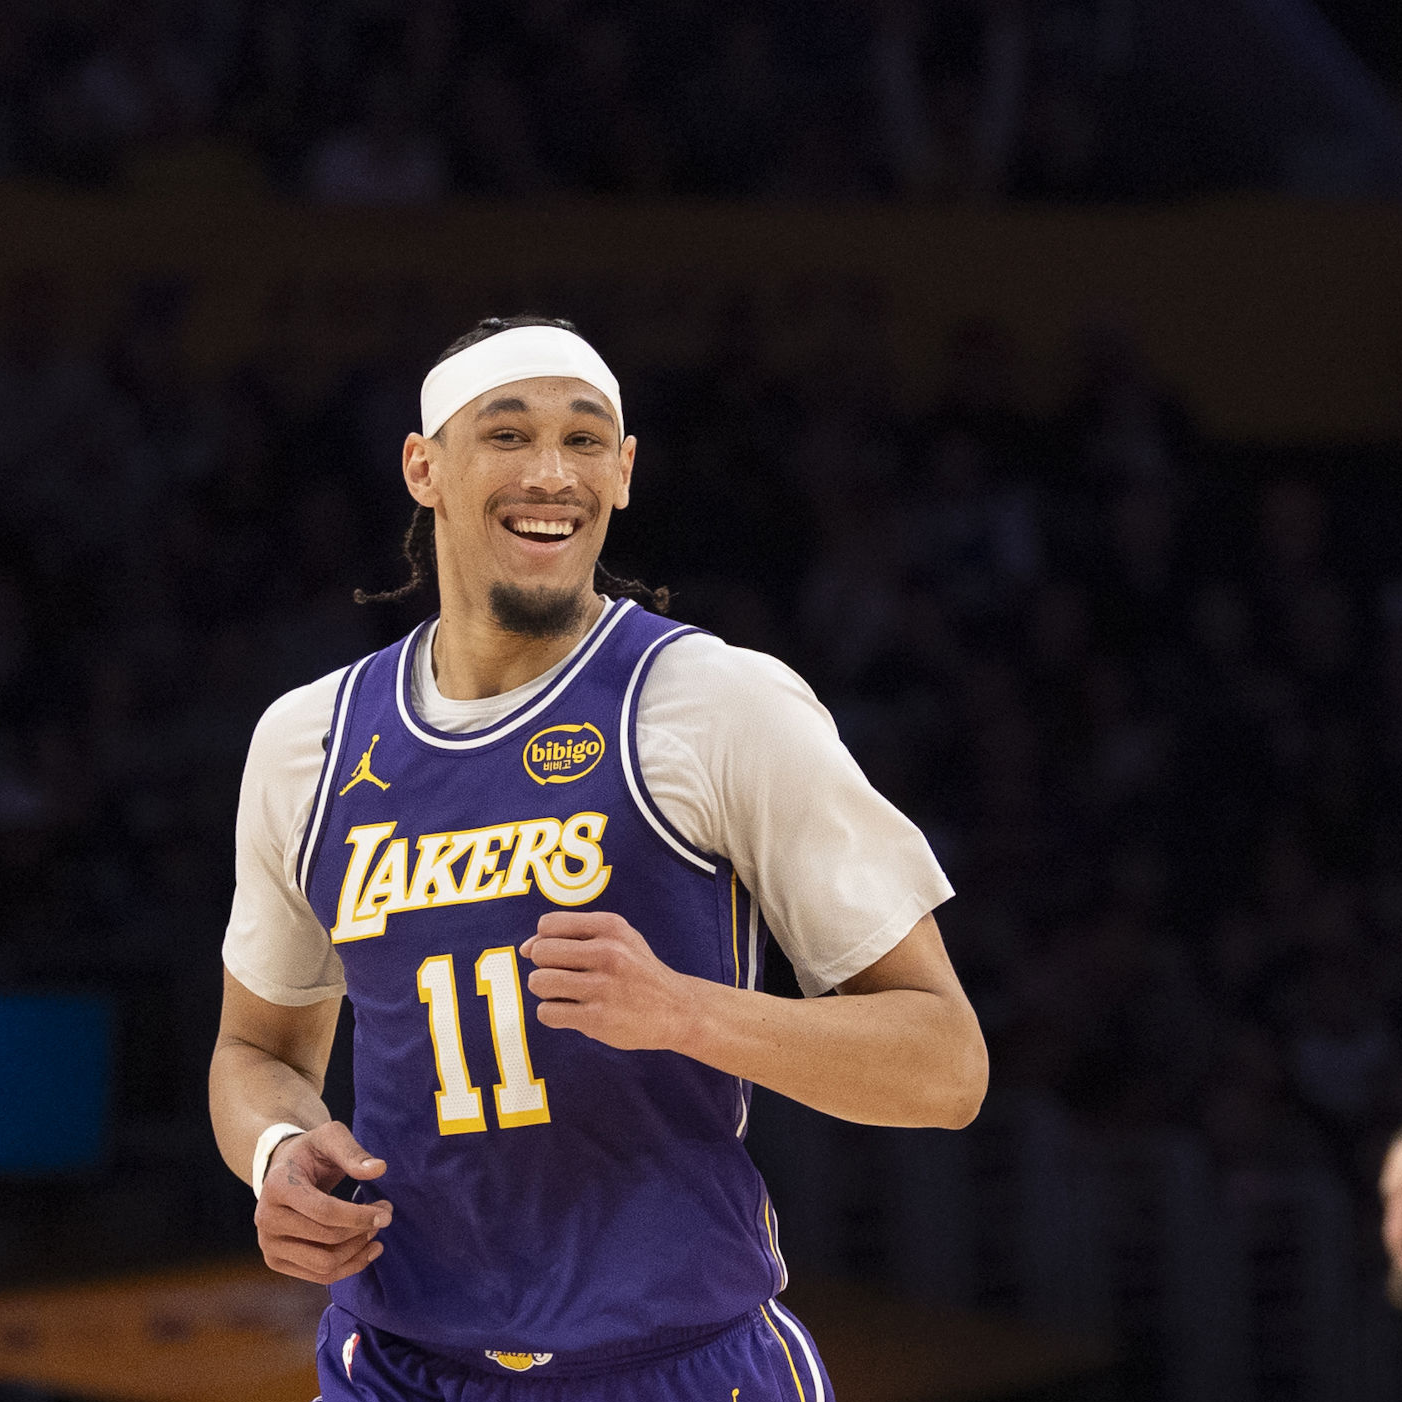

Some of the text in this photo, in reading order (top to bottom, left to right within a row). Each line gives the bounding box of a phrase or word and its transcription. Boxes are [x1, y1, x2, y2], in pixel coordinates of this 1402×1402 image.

[531, 739, 600, 764] bibigo
[543, 760, 572, 772] 비비고
[331, 812, 612, 944] LAKERS
[416, 946, 551, 1136] 11
